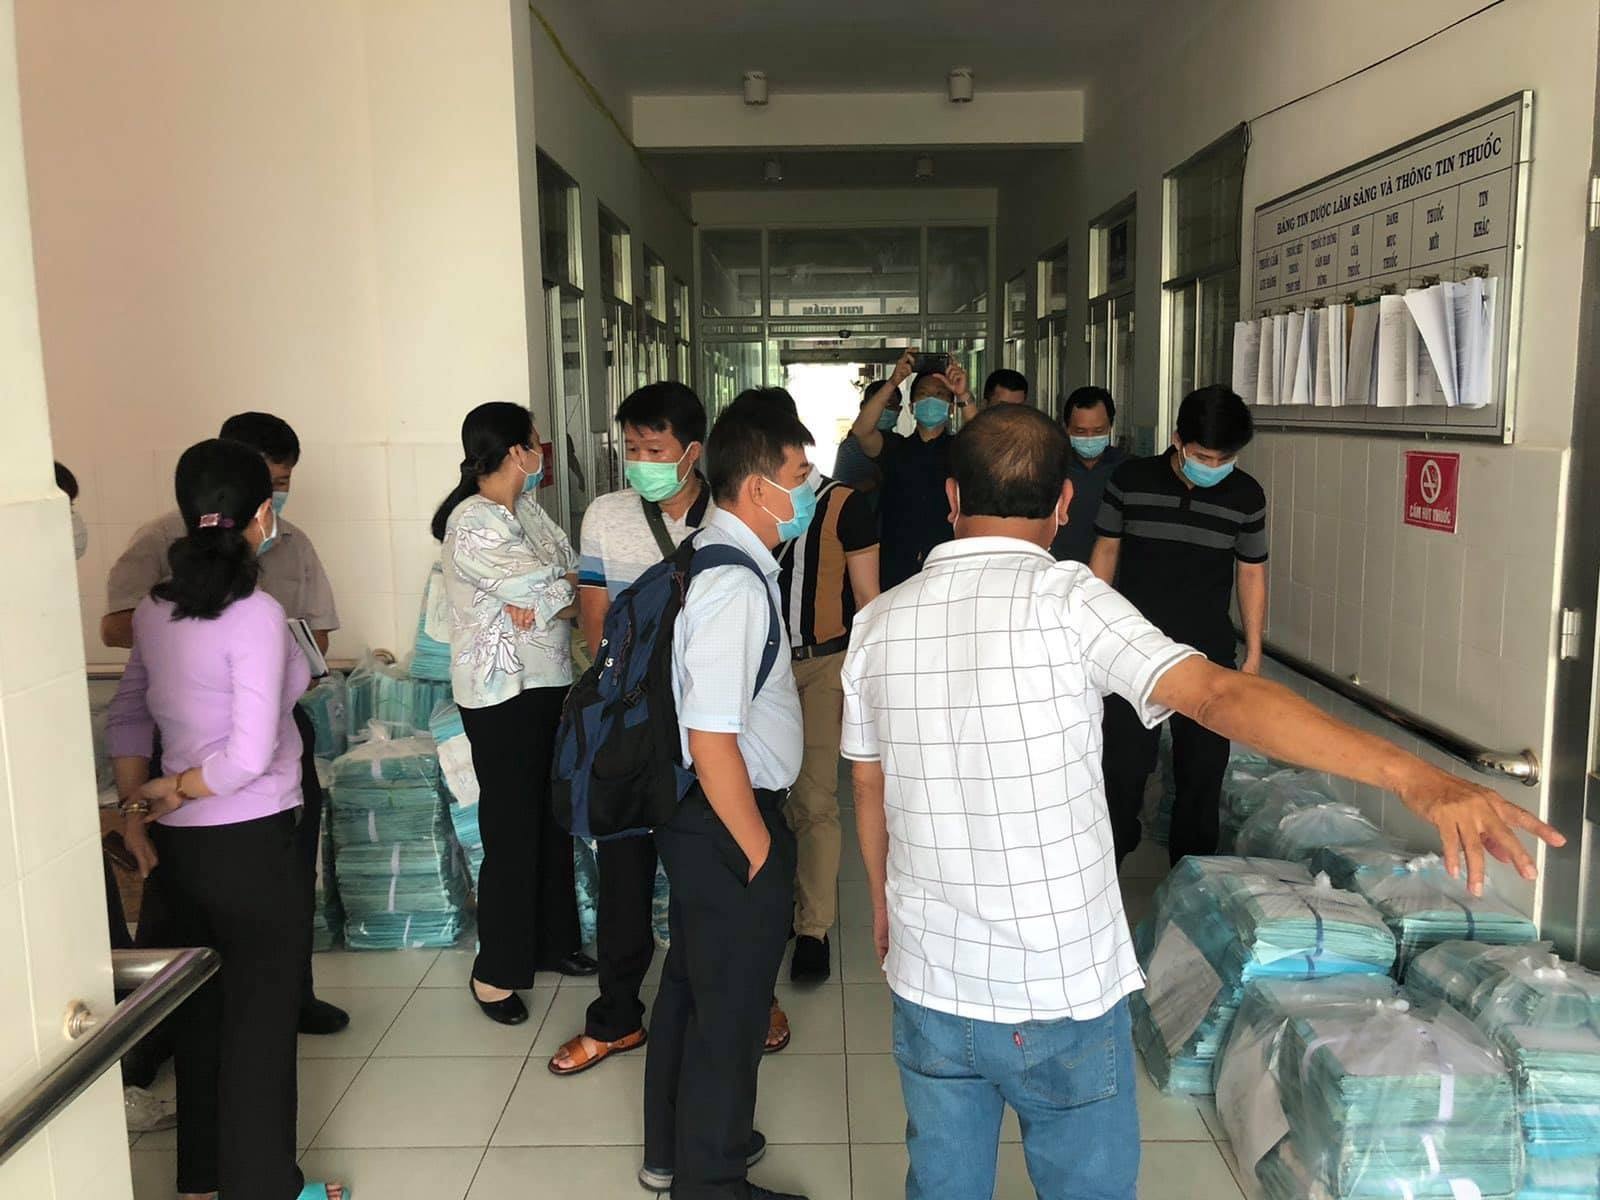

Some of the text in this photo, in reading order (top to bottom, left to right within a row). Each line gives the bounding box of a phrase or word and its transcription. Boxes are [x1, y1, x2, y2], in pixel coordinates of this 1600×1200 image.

[1276, 216, 1295, 235] BẢNG
[1297, 215, 1309, 228] TIN
[1380, 176, 1393, 197] VÀ
[1396, 165, 1432, 192] THÔNG
[1435, 154, 1455, 177] TIN
[1459, 131, 1502, 169] THUỐC
